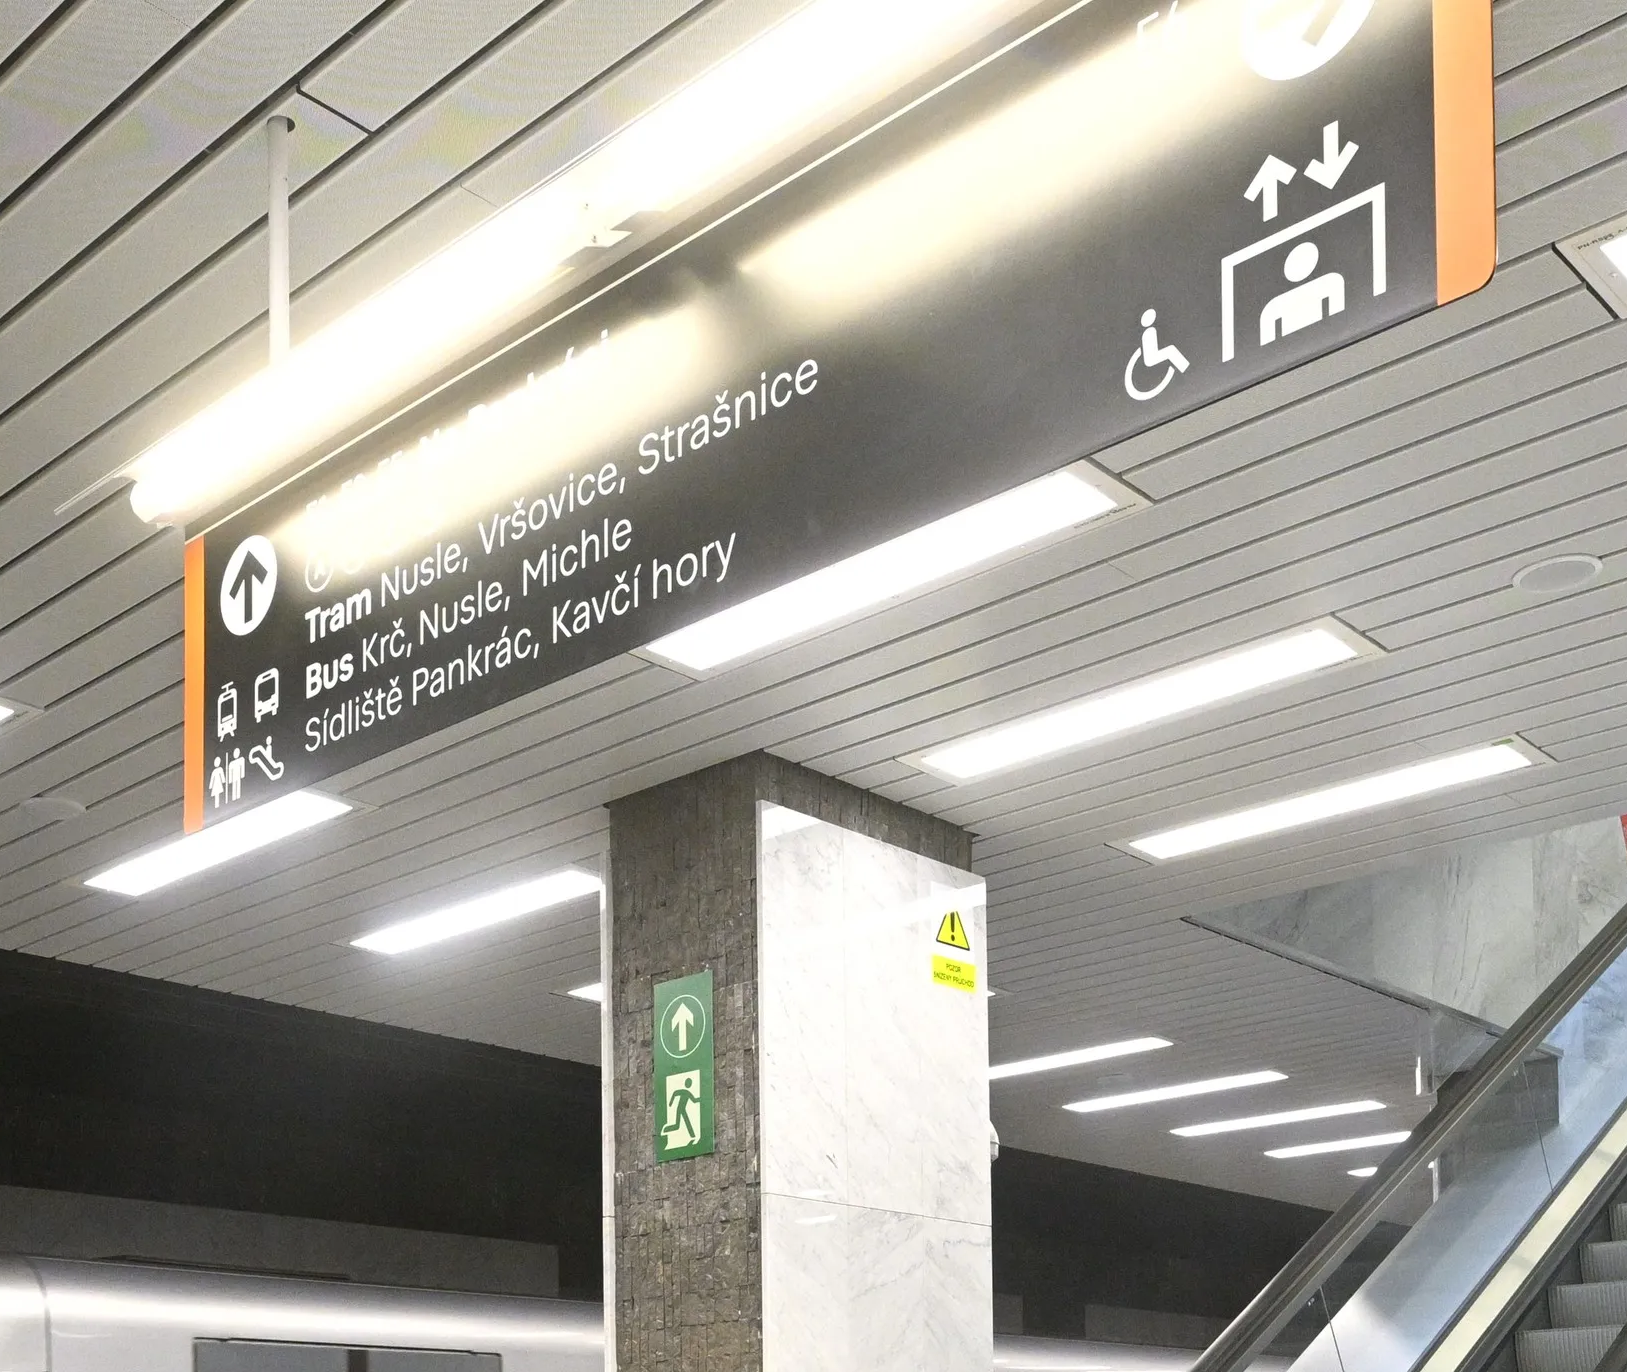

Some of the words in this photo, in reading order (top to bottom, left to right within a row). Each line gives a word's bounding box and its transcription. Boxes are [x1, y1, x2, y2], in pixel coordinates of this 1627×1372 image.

[305, 589, 371, 644] Tram
[382, 543, 469, 607] Nusle,
[478, 463, 626, 555] Vršovice,
[638, 358, 818, 475] Strašnice
[305, 652, 355, 700] Bus
[363, 617, 413, 673] Krč,
[420, 579, 511, 646] Nusle,
[523, 517, 633, 597] Michle
[305, 675, 403, 753] Sídliště
[413, 625, 540, 707] Pankrác,
[553, 563, 642, 645] Kavčí
[653, 531, 737, 600] hory
